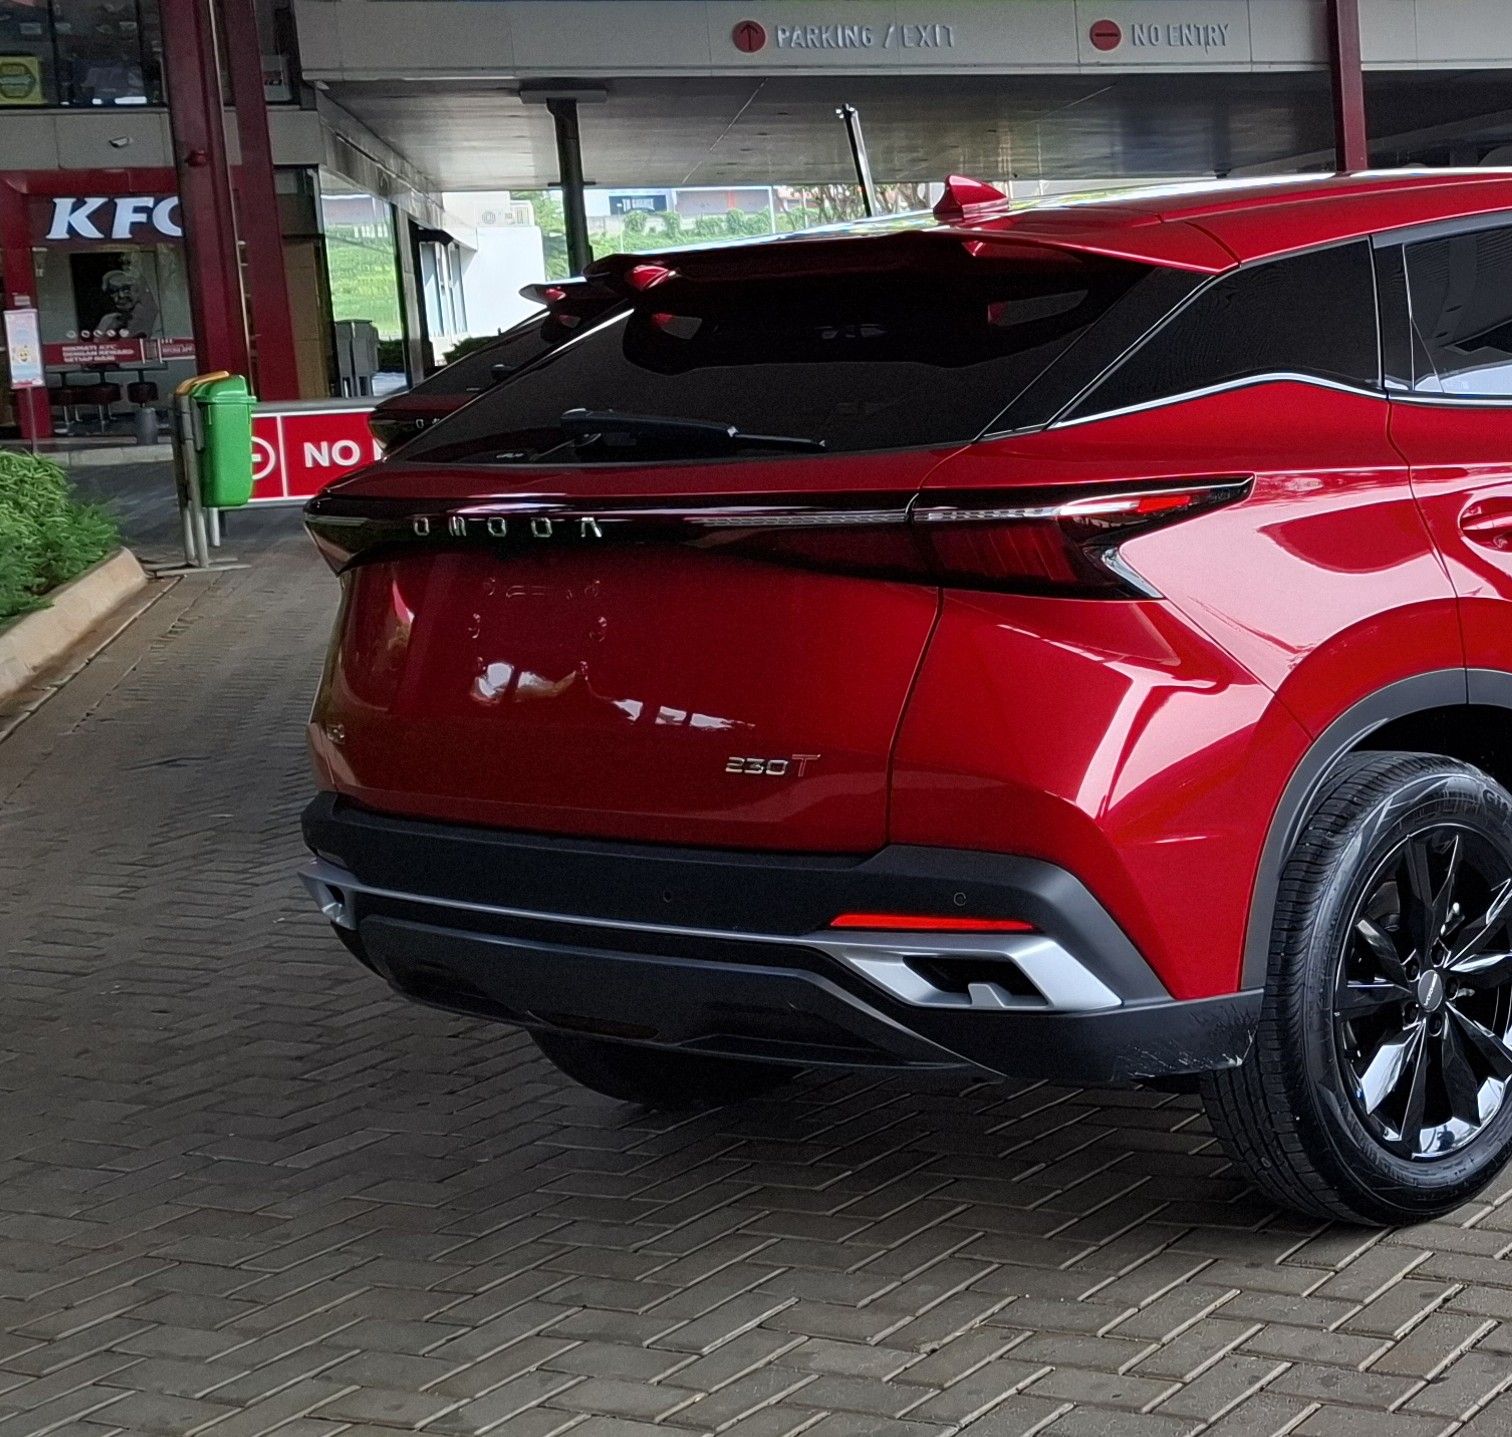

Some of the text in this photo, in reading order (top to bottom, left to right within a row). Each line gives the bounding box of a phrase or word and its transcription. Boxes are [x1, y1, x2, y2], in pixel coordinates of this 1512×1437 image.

[777, 24, 874, 48] PARKING
[1131, 23, 1228, 47] NO ENTRY
[45, 196, 183, 239] KFC
[303, 439, 361, 468] NO
